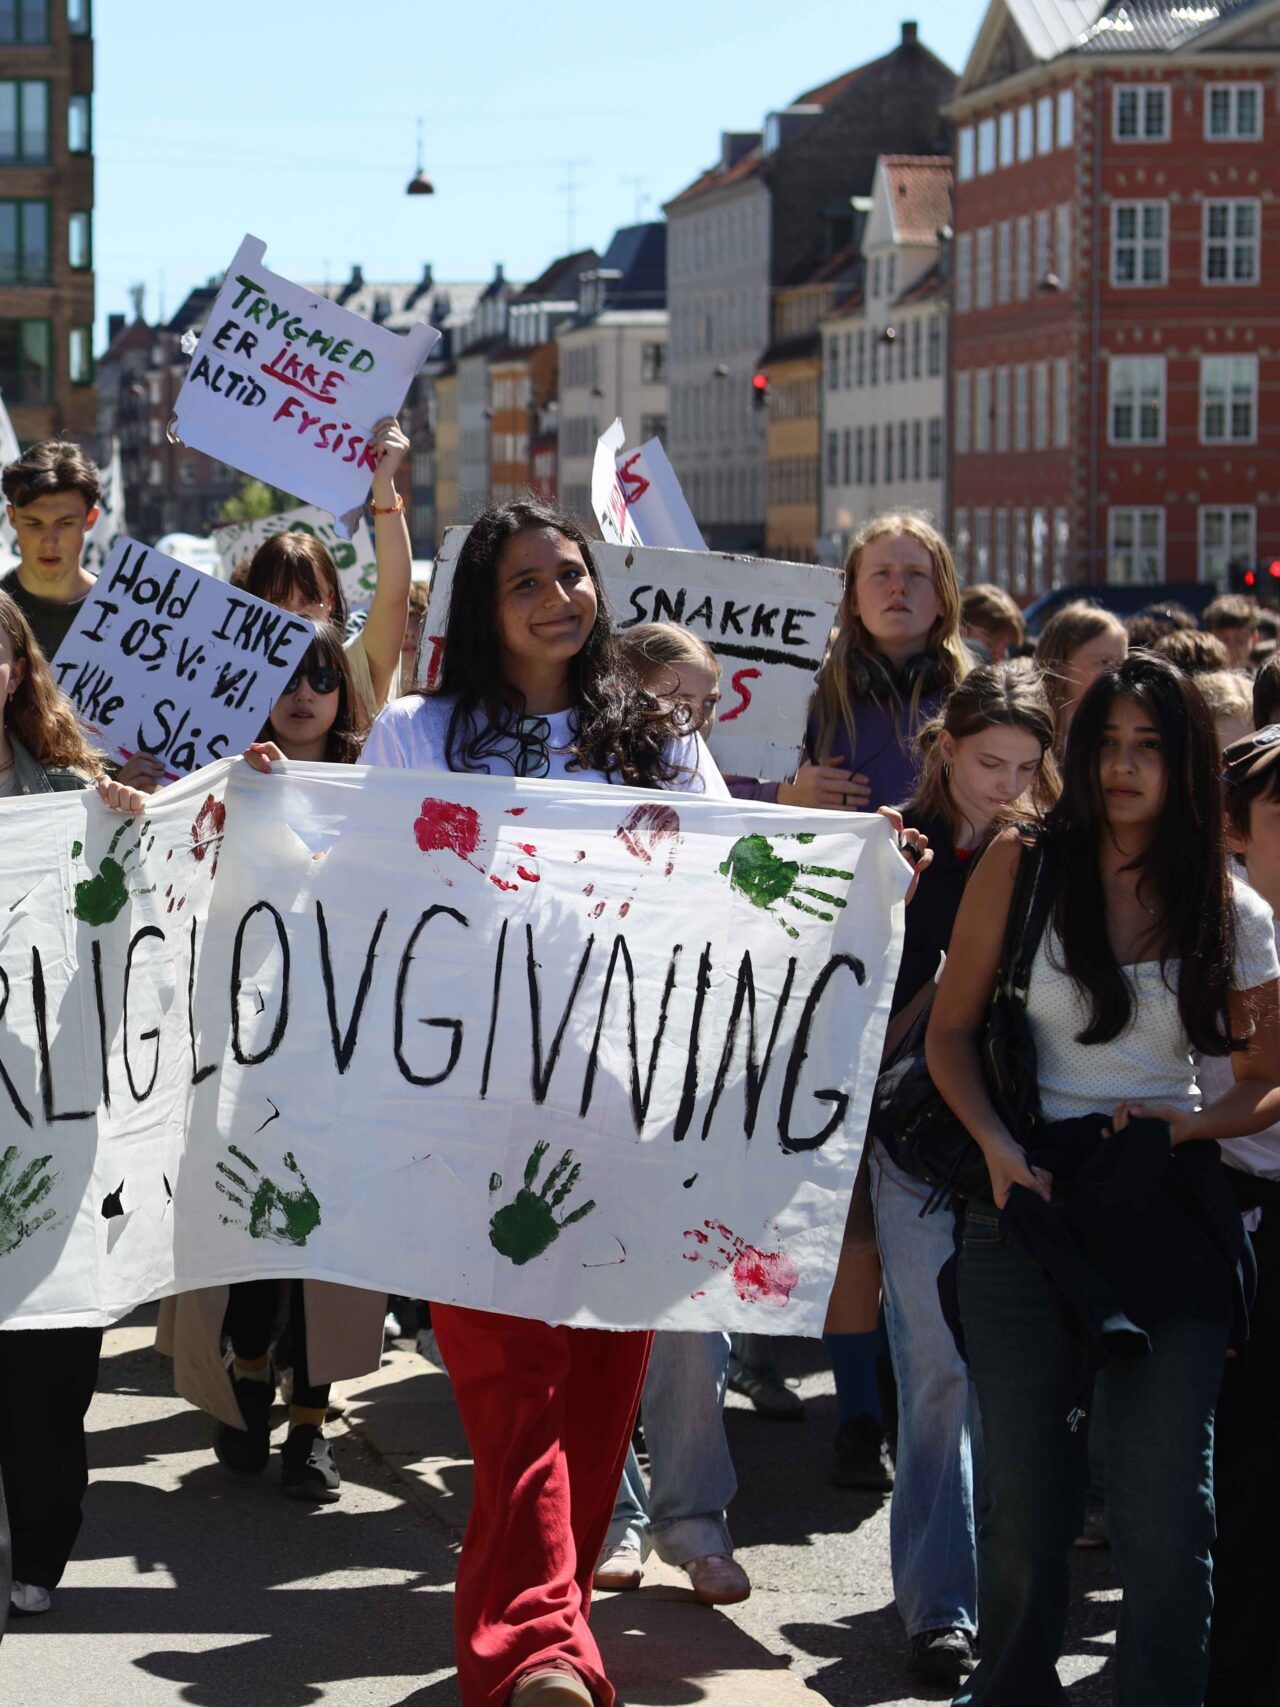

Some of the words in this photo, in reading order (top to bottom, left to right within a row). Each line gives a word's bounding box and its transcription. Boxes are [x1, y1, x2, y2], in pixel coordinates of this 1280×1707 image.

[211, 319, 259, 359] ER
[235, 275, 375, 373] TRYGHED
[80, 599, 119, 642] I
[108, 543, 200, 619] Hold
[212, 597, 308, 668] IKKE
[618, 585, 816, 647] SNAKKE
